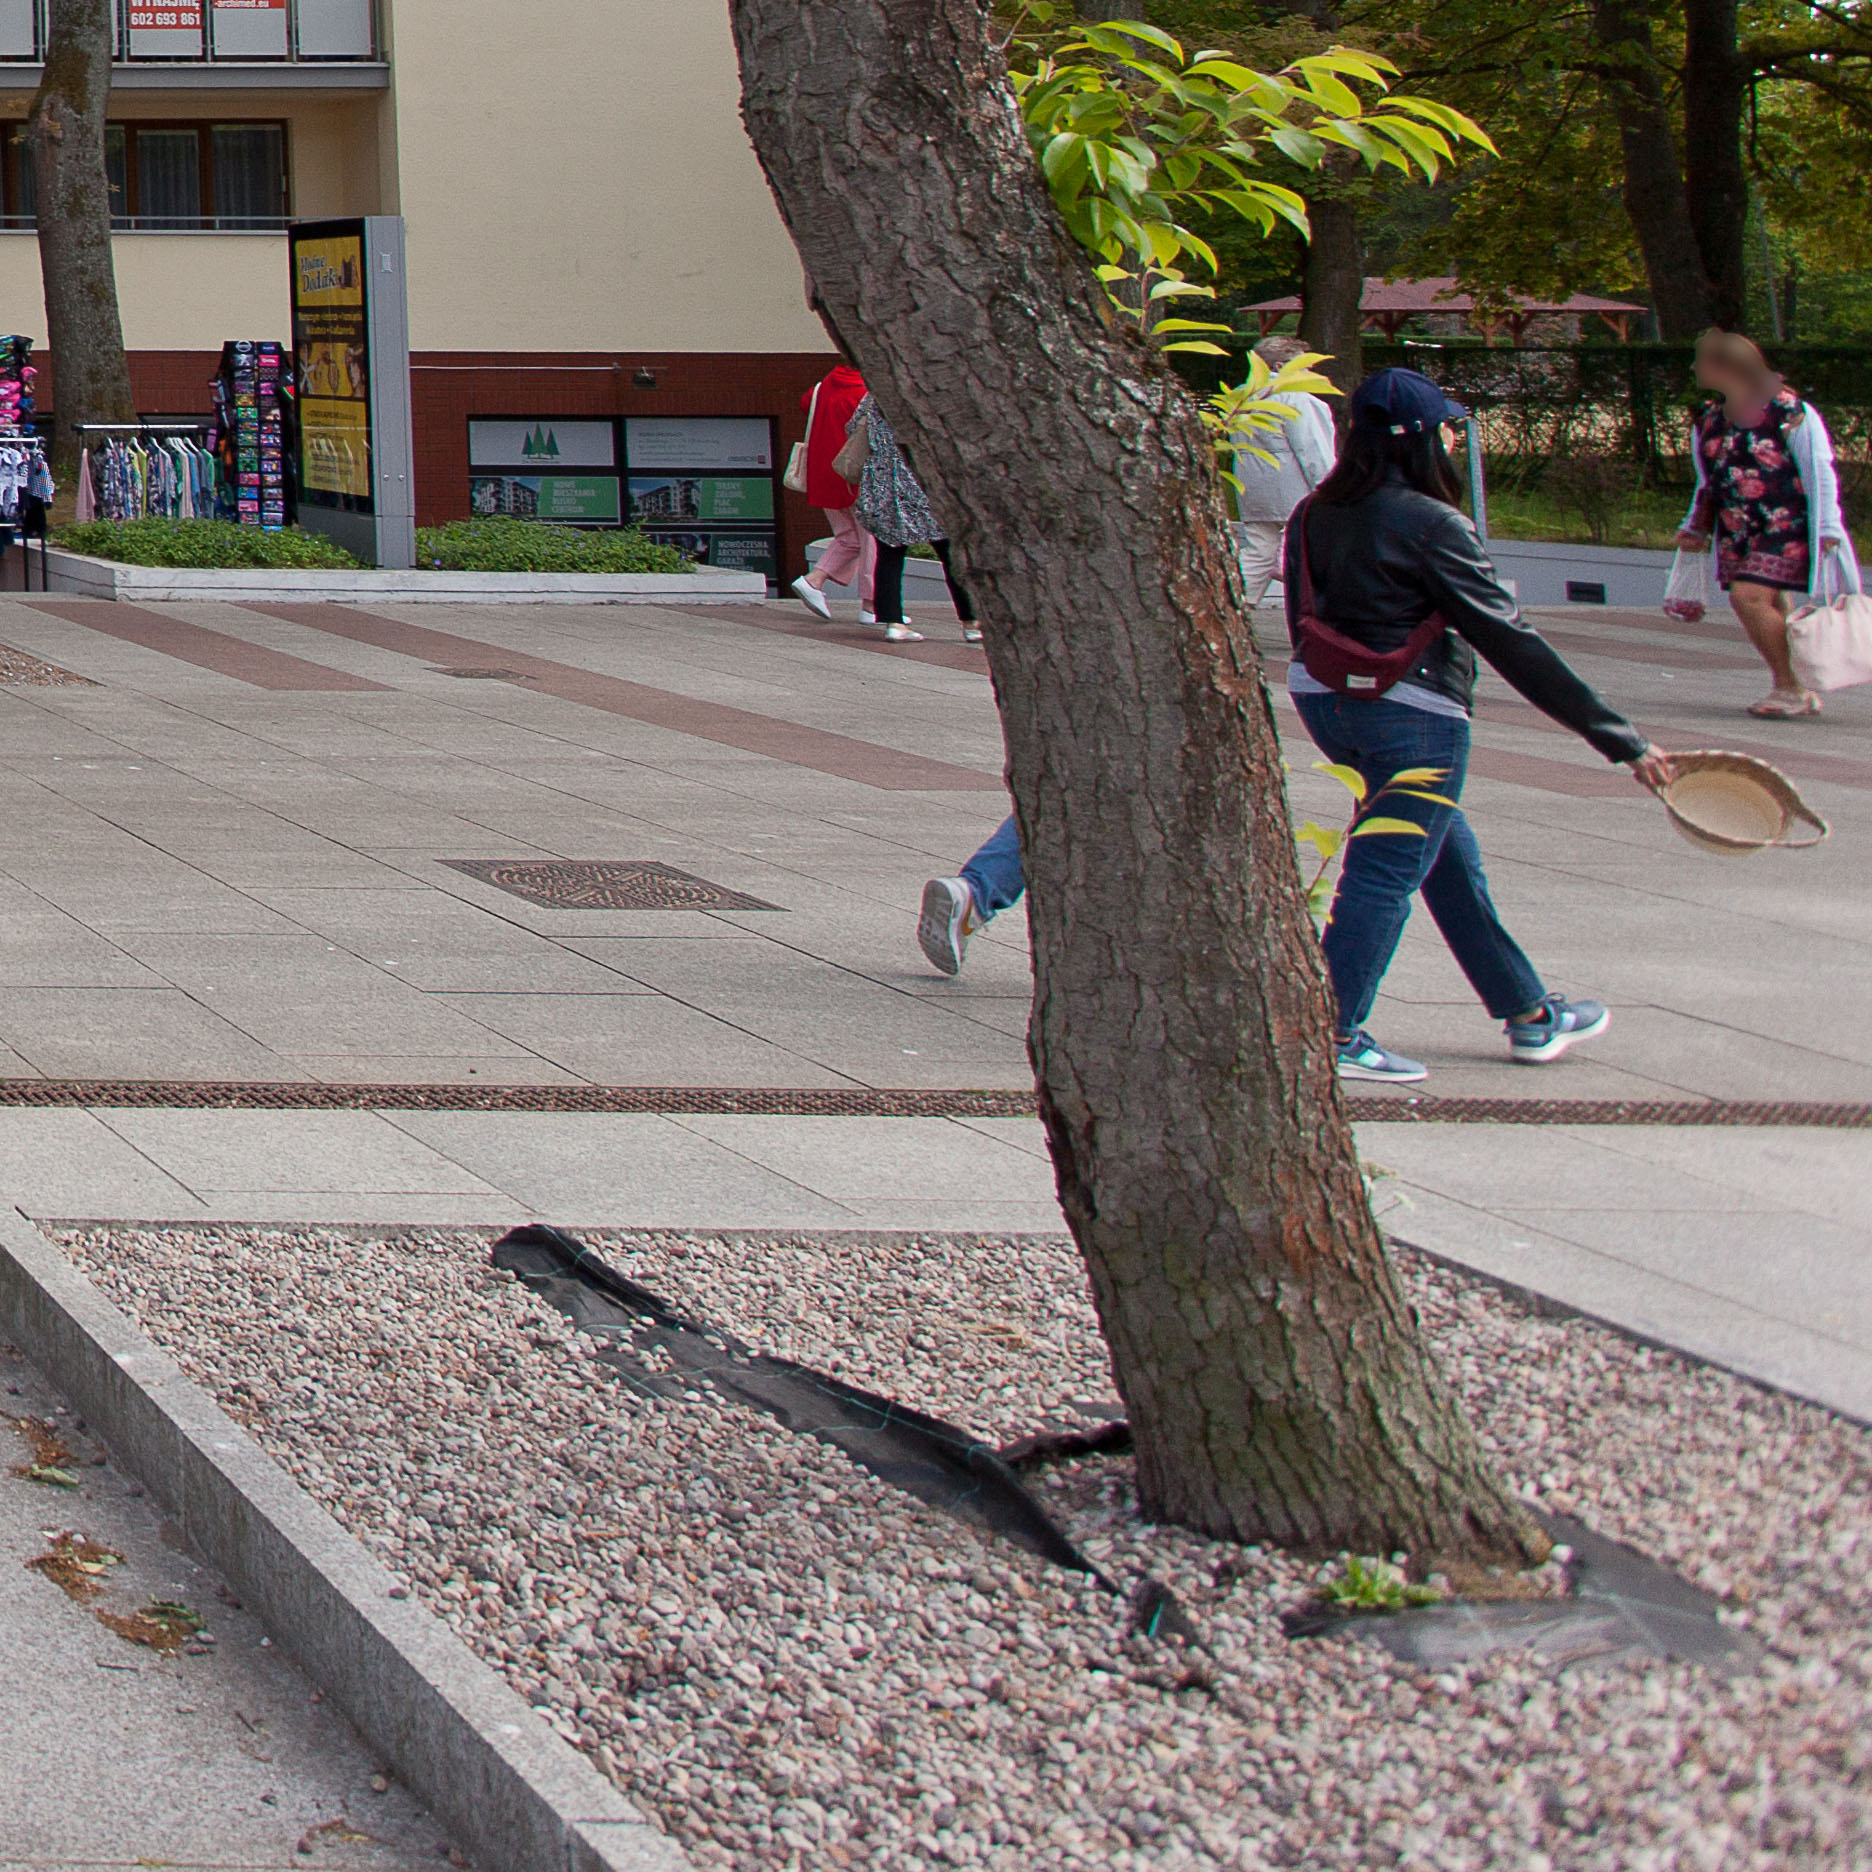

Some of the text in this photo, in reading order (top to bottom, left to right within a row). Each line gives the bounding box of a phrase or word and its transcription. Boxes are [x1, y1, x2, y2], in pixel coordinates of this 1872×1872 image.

[131, 12, 200, 25] 602 693 861
